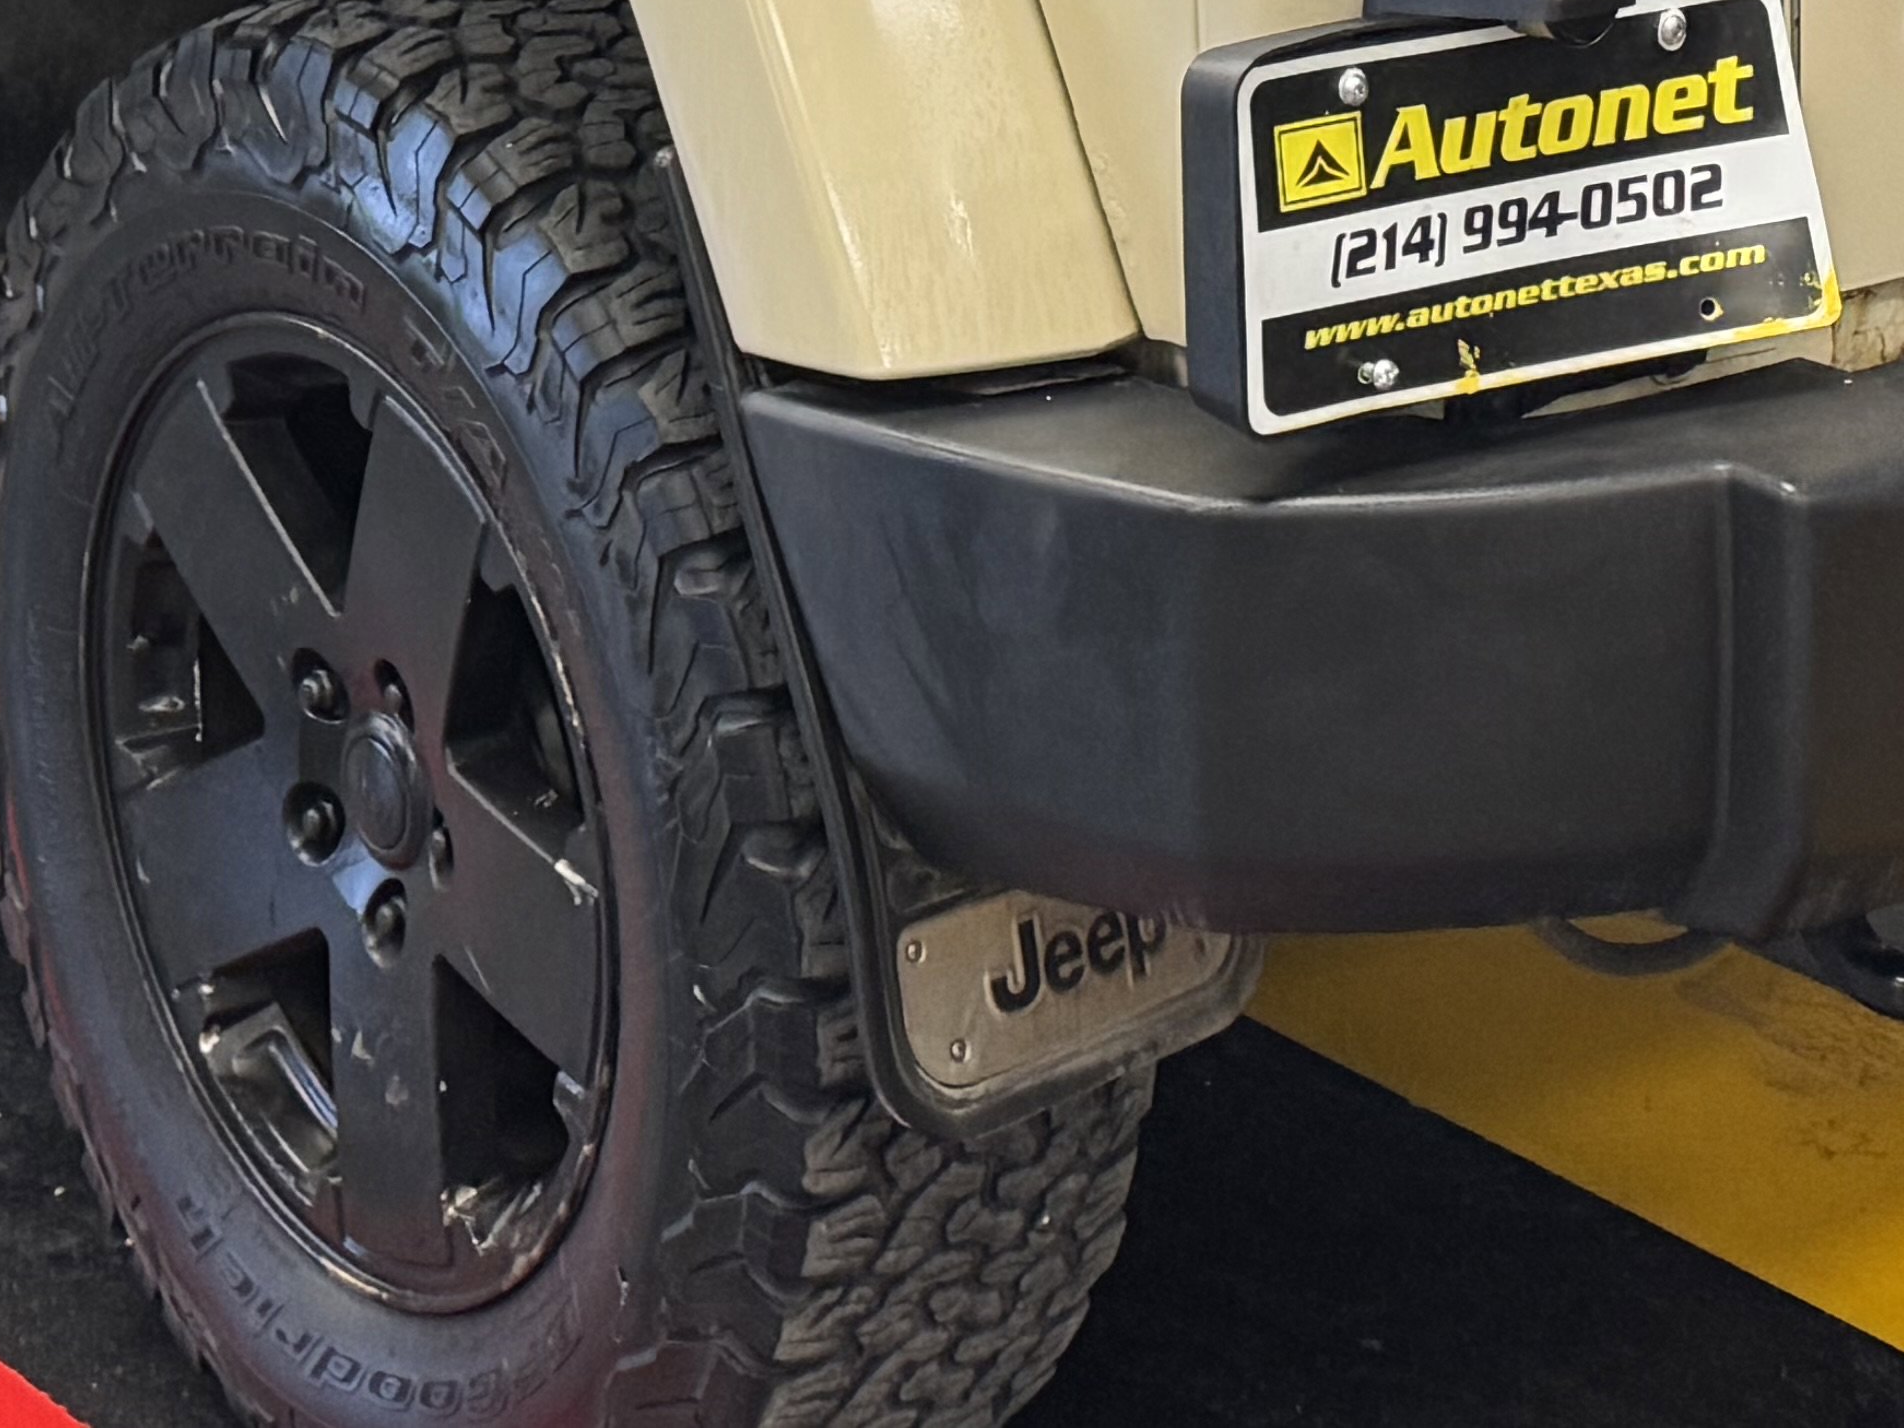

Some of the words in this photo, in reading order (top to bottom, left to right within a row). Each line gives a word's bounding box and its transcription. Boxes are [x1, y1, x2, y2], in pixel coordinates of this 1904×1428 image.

[1370, 55, 1755, 190] Autonet
[1330, 213, 1448, 288] (214)
[1462, 162, 1725, 254] 994-0502
[1303, 243, 1766, 351] www.autonettexas.com
[987, 909, 1167, 1015] Jeep
